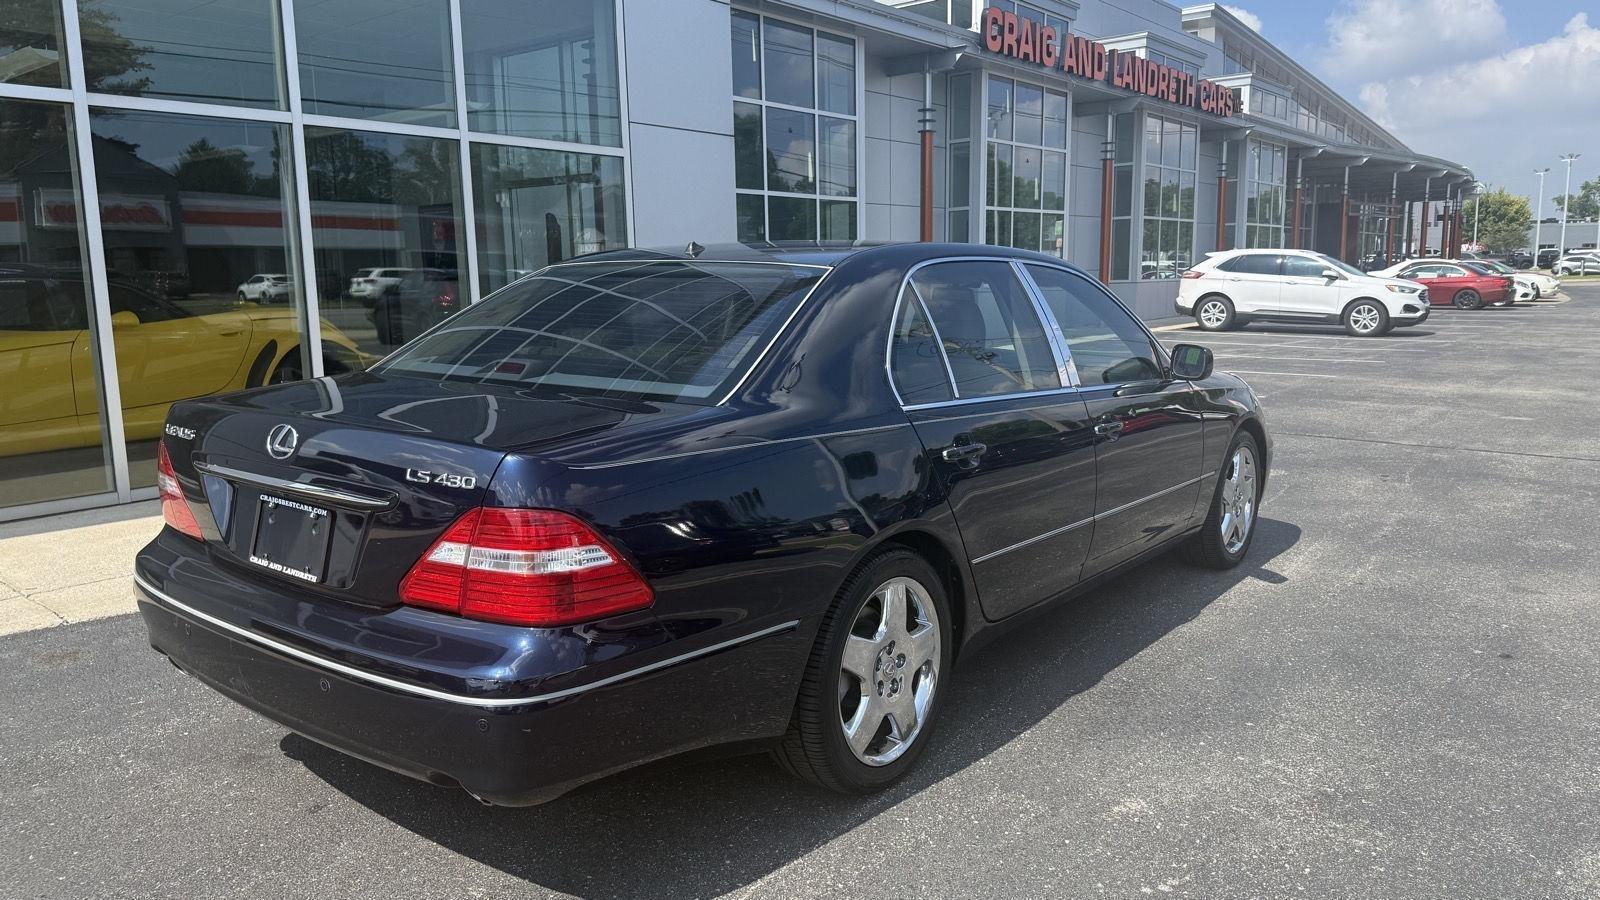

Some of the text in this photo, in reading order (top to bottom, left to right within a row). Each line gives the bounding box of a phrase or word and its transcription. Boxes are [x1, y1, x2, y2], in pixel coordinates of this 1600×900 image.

[984, 7, 1233, 117] CRAIG AND LANDRETH CARS
[406, 468, 476, 490] LS 430
[260, 494, 328, 516] CRAIGSBESTCARS.COM
[249, 556, 318, 582] CRAIG AND LANDRETH
